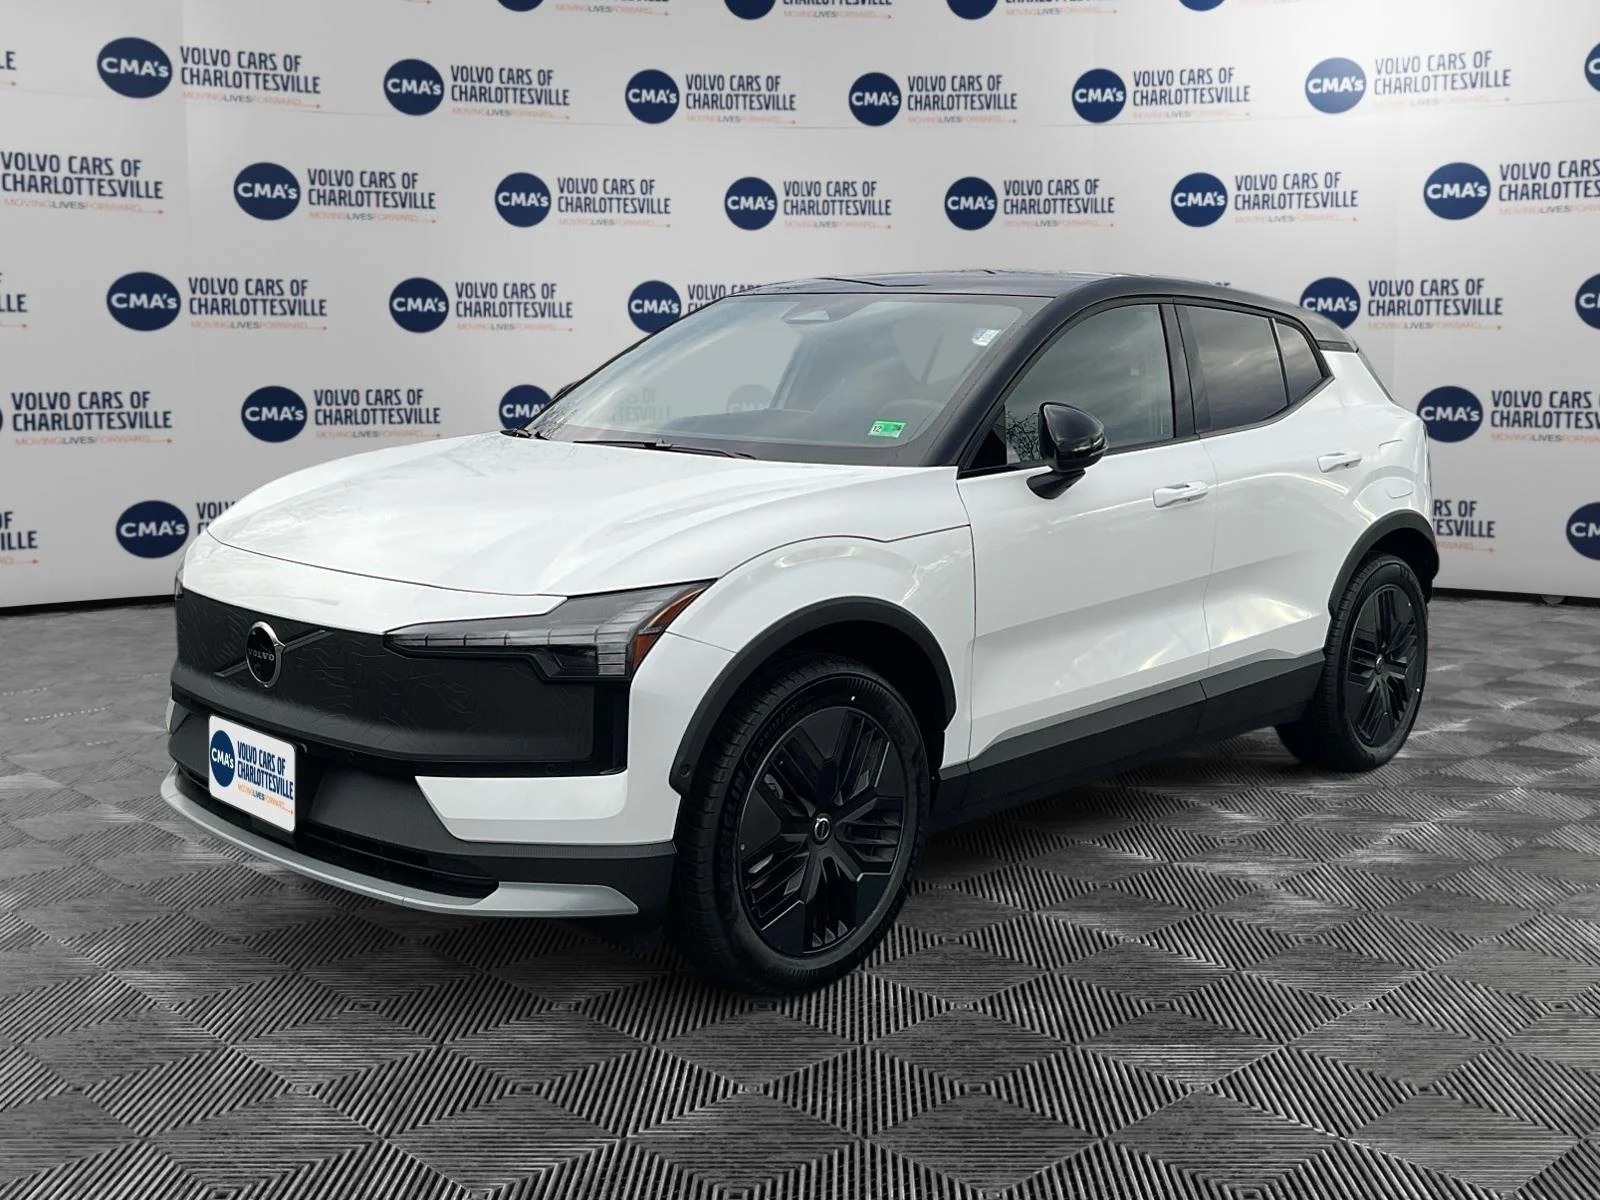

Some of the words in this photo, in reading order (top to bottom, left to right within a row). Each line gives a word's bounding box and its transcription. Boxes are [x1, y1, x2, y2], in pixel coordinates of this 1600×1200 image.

[101, 57, 169, 77] CMA's
[180, 46, 231, 68] VOLVO
[237, 51, 277, 71] CARS
[283, 54, 301, 72] OF
[1375, 56, 1421, 76] VOLVO
[1427, 52, 1467, 72] CARS
[1473, 50, 1493, 69] OF
[181, 66, 321, 94] CHARLOTTESVILLE
[450, 65, 494, 84] VOLVO
[499, 67, 533, 86] CARS
[537, 69, 554, 87] OF
[685, 74, 725, 91] VOLVO
[729, 75, 762, 92] CARS
[766, 75, 781, 92] OF
[908, 75, 946, 93] VOLVO
[951, 75, 983, 92] CARS
[987, 74, 1002, 92] OF
[1133, 70, 1174, 88] VOLVO
[1179, 68, 1213, 86] CARS
[1218, 67, 1234, 84] OF
[1308, 76, 1364, 94] CMA's
[1374, 68, 1512, 95] CHARLOTTESVILLE
[387, 78, 441, 95] CMA's
[451, 84, 570, 106] CHARLOTTESVILLE
[1075, 88, 1124, 103] CMA's
[628, 89, 677, 104] CMA's
[686, 92, 796, 111] CHARLOTTESVILLE
[851, 92, 899, 106] CMA's
[907, 93, 1017, 111] CHARLOTTESVILLE
[1133, 86, 1250, 107] CHARLOTTESVILLE
[0, 151, 60, 173] VOLVO
[68, 156, 114, 176] CARS
[121, 159, 142, 177] OF
[1500, 161, 1551, 181] VOLVO
[1558, 159, 1600, 178] CARS
[2, 173, 164, 199] CHARLOTTESVILLE
[307, 168, 354, 187] VOLVO
[360, 171, 396, 189] CARS
[401, 172, 418, 190] OF
[557, 177, 598, 195] VOLVO
[603, 178, 635, 195] CARS
[640, 179, 655, 196] OF
[1003, 179, 1043, 197] VOLVO
[1048, 179, 1080, 196] CARS
[1084, 178, 1100, 195] OF
[1235, 174, 1277, 192] VOLVO
[1283, 172, 1318, 190] CARS
[1324, 171, 1341, 189] OF
[237, 182, 297, 199] CMA's
[783, 181, 822, 197] VOLVO
[826, 181, 858, 197] CARS
[862, 181, 877, 197] OF
[1427, 182, 1487, 199] CMA's
[1499, 179, 1600, 202] CHARLOTTES
[308, 188, 436, 210] CHARLOTTESVILLE
[498, 192, 549, 207] CMA's
[558, 196, 671, 214] CHARLOTTESVILLE
[727, 196, 775, 210] CMA's
[783, 199, 892, 216] CHARLOTTESVILLE
[947, 196, 995, 210] CMA's
[1003, 197, 1115, 215] CHARLOTTESVILLE
[1174, 191, 1225, 207] CMA's
[1234, 190, 1358, 211] CHARLOTTESVILLE
[188, 277, 238, 296] VOLVO
[245, 278, 284, 296] CARS
[290, 279, 308, 297] OF
[455, 282, 498, 299] VOLVO
[503, 282, 536, 299] CARS
[541, 283, 557, 300] OF
[687, 284, 727, 300] VOLVO
[1368, 279, 1414, 298] VOLVO
[1420, 279, 1459, 297] CARS
[1465, 278, 1485, 296] OF
[111, 293, 177, 309] CMA's
[189, 297, 327, 316] CHARLOTTESVILLE
[392, 297, 446, 312] CMA's
[456, 300, 573, 318] CHARLOTTESVILLE
[631, 299, 679, 314] CMA's
[1303, 296, 1357, 313] CMA's
[1368, 297, 1503, 317] CHARLOTTESVILLE
[11, 392, 71, 411] VOLVO
[78, 391, 124, 410] CARS
[130, 391, 150, 409] OF
[314, 389, 360, 407] VOLVO
[365, 389, 402, 406] CARS
[407, 389, 424, 406] OF
[1491, 390, 1542, 408] VOLVO
[1549, 391, 1592, 409] CARS
[245, 406, 304, 421] CMA's
[314, 407, 441, 426] CHARLOTTESVILLE
[502, 403, 546, 419] CMA'
[1420, 406, 1480, 421] CMA's
[1491, 410, 1600, 429] CHARLOTTESV
[12, 411, 172, 432] CHARLOTTESVILLE
[1433, 500, 1452, 517] RS
[1458, 500, 1477, 518] OF
[120, 520, 185, 537] CMA's
[249, 649, 274, 661] VOLVO
[211, 747, 234, 769] CMA's
[237, 741, 257, 766] VOLVO
[259, 750, 276, 773] CARS
[277, 756, 286, 777] OF
[237, 761, 294, 801] CHARLOTTESVILLE
